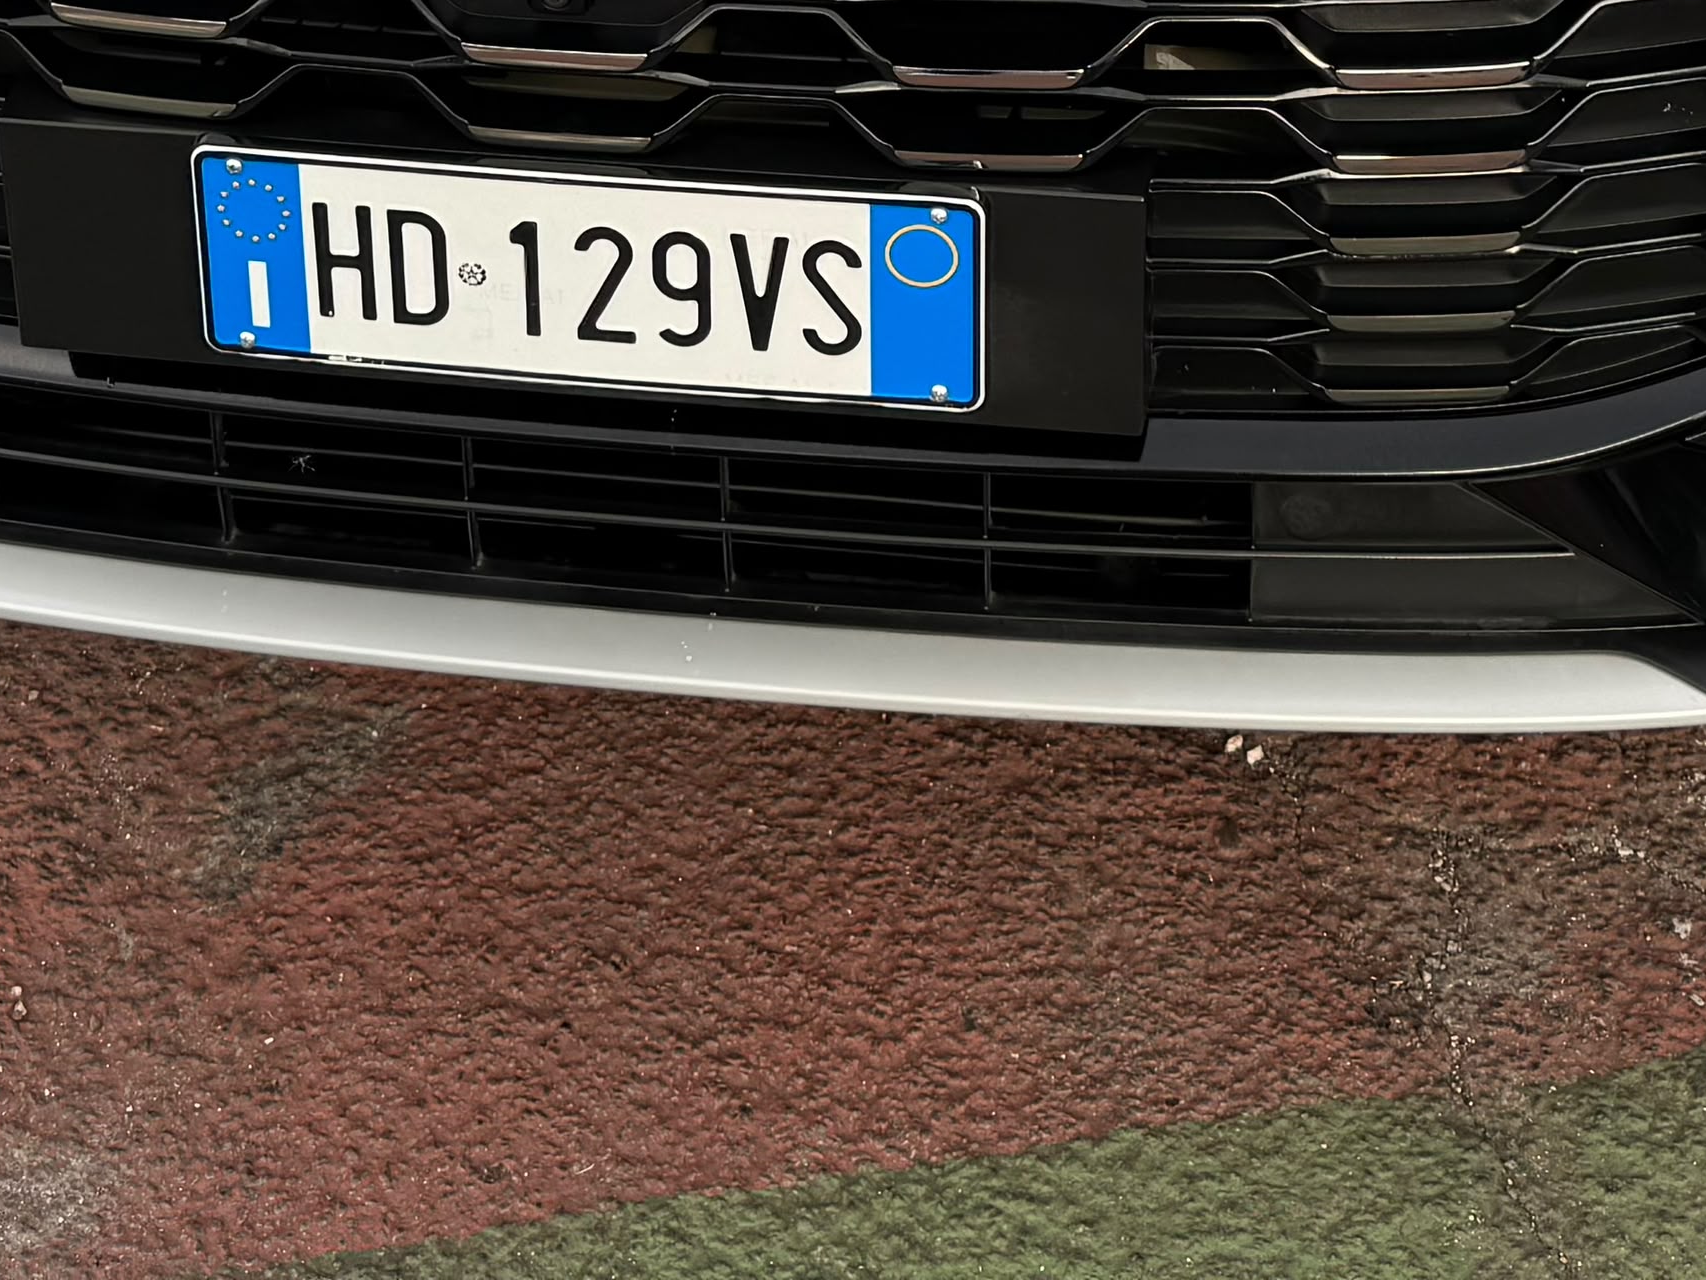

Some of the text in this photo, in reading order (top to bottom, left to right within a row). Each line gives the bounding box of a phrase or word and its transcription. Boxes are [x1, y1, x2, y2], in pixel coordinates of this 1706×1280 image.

[248, 201, 863, 357] I HD 129VS
